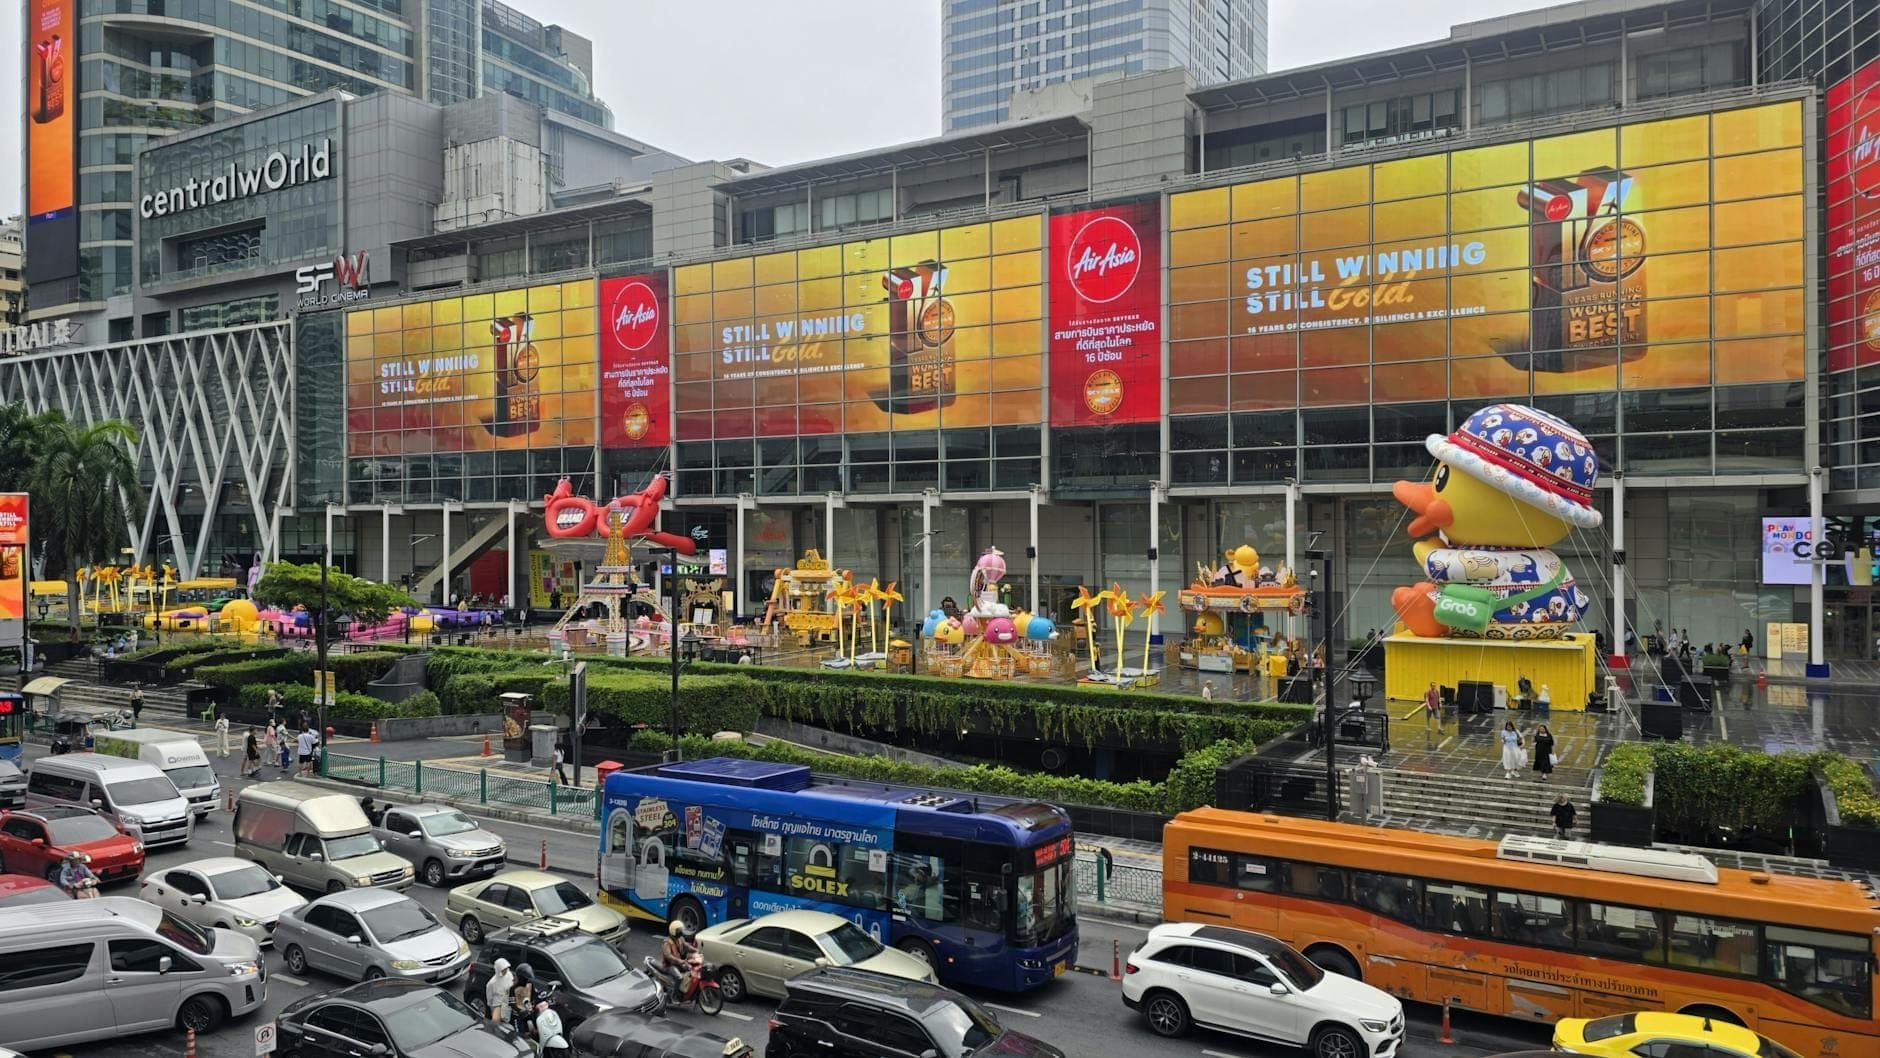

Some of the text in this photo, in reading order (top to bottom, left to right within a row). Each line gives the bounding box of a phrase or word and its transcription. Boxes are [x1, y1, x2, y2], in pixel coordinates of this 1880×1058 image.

[140, 138, 331, 219] centralwOrld
[1073, 242, 1136, 279] AirAsia
[1247, 241, 1486, 289] STILL WINNING
[297, 289, 368, 307] WORLD CINEMA
[1247, 287, 1325, 314] STILL
[616, 302, 656, 331] AirAsia
[1258, 323, 1285, 333] YEARS
[1300, 316, 1362, 329] CONSISTENCY,
[1364, 310, 1415, 324] RSILIENCE
[1569, 308, 1641, 343] BEST
[722, 313, 865, 344] STILL WINNING
[722, 344, 770, 364] STILL
[1085, 353, 1096, 363] 16
[381, 354, 479, 378] STILL WINNING
[381, 378, 414, 394] STILL
[912, 368, 953, 392] BEST
[510, 399, 539, 419] BEST
[1767, 524, 1795, 533] PLAY
[1440, 598, 1477, 617] Grab
[640, 813, 661, 823] STEEL
[751, 814, 878, 845] โซเล็กซ์ กุญแจไทย มาตรฐานโลก
[791, 874, 849, 897] SOLEX
